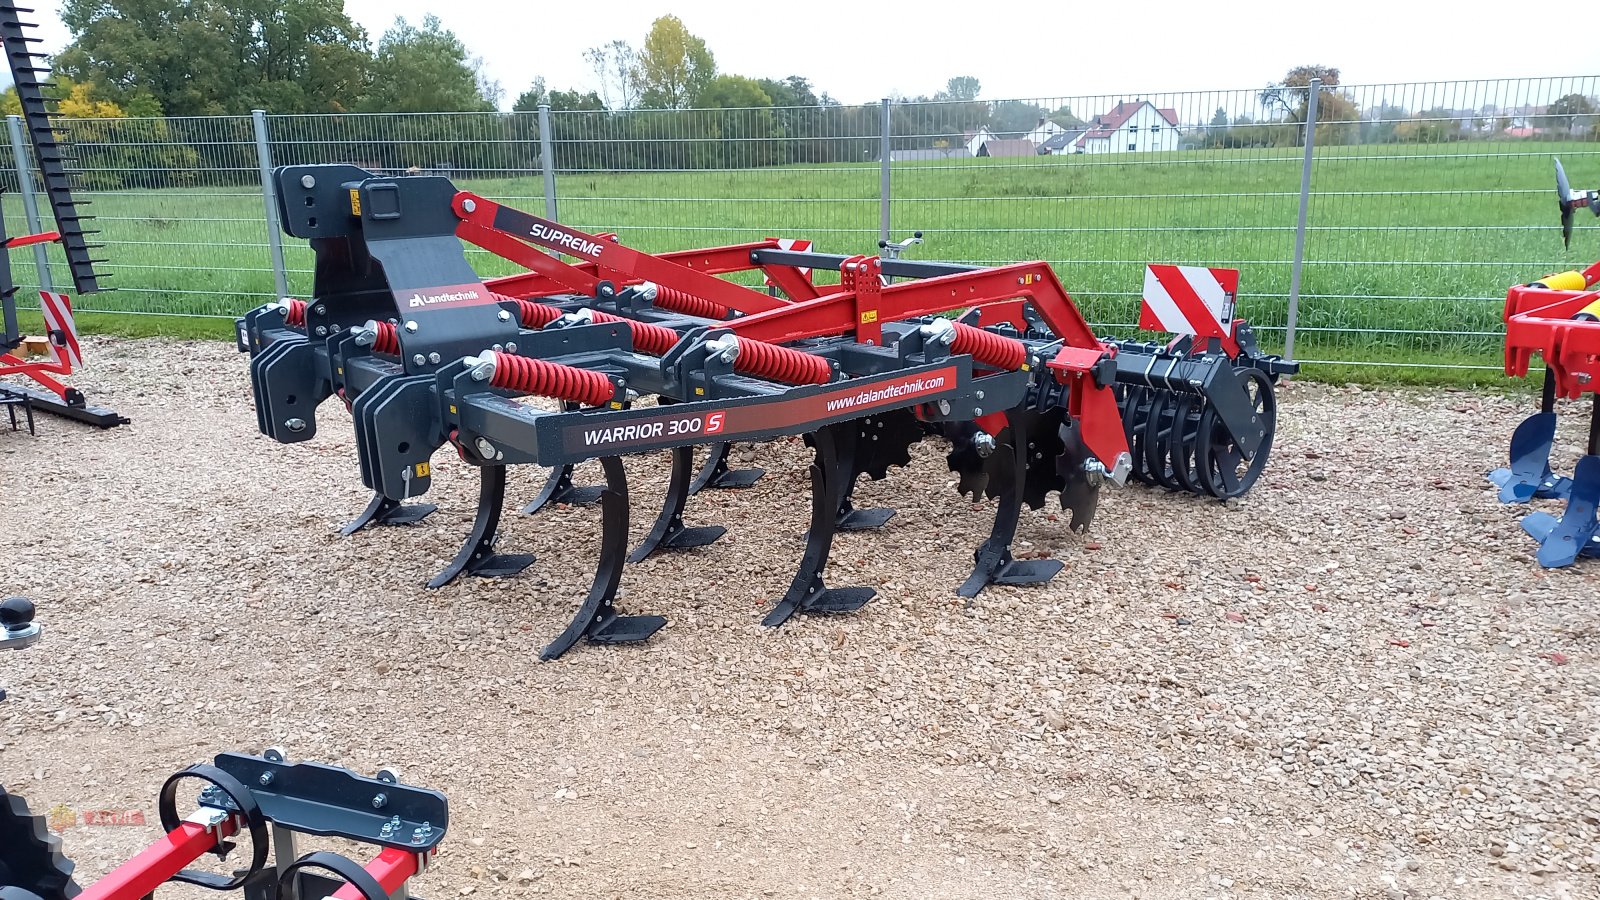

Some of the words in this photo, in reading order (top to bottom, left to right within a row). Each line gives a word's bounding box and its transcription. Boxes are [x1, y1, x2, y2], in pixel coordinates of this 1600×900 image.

[530, 223, 604, 257] SUPREME
[424, 291, 479, 304] Landtechnik
[826, 376, 944, 412] www.dalandtechnik.com
[584, 422, 664, 446] WARRIOR
[668, 417, 701, 435] 300
[706, 413, 722, 432] S
